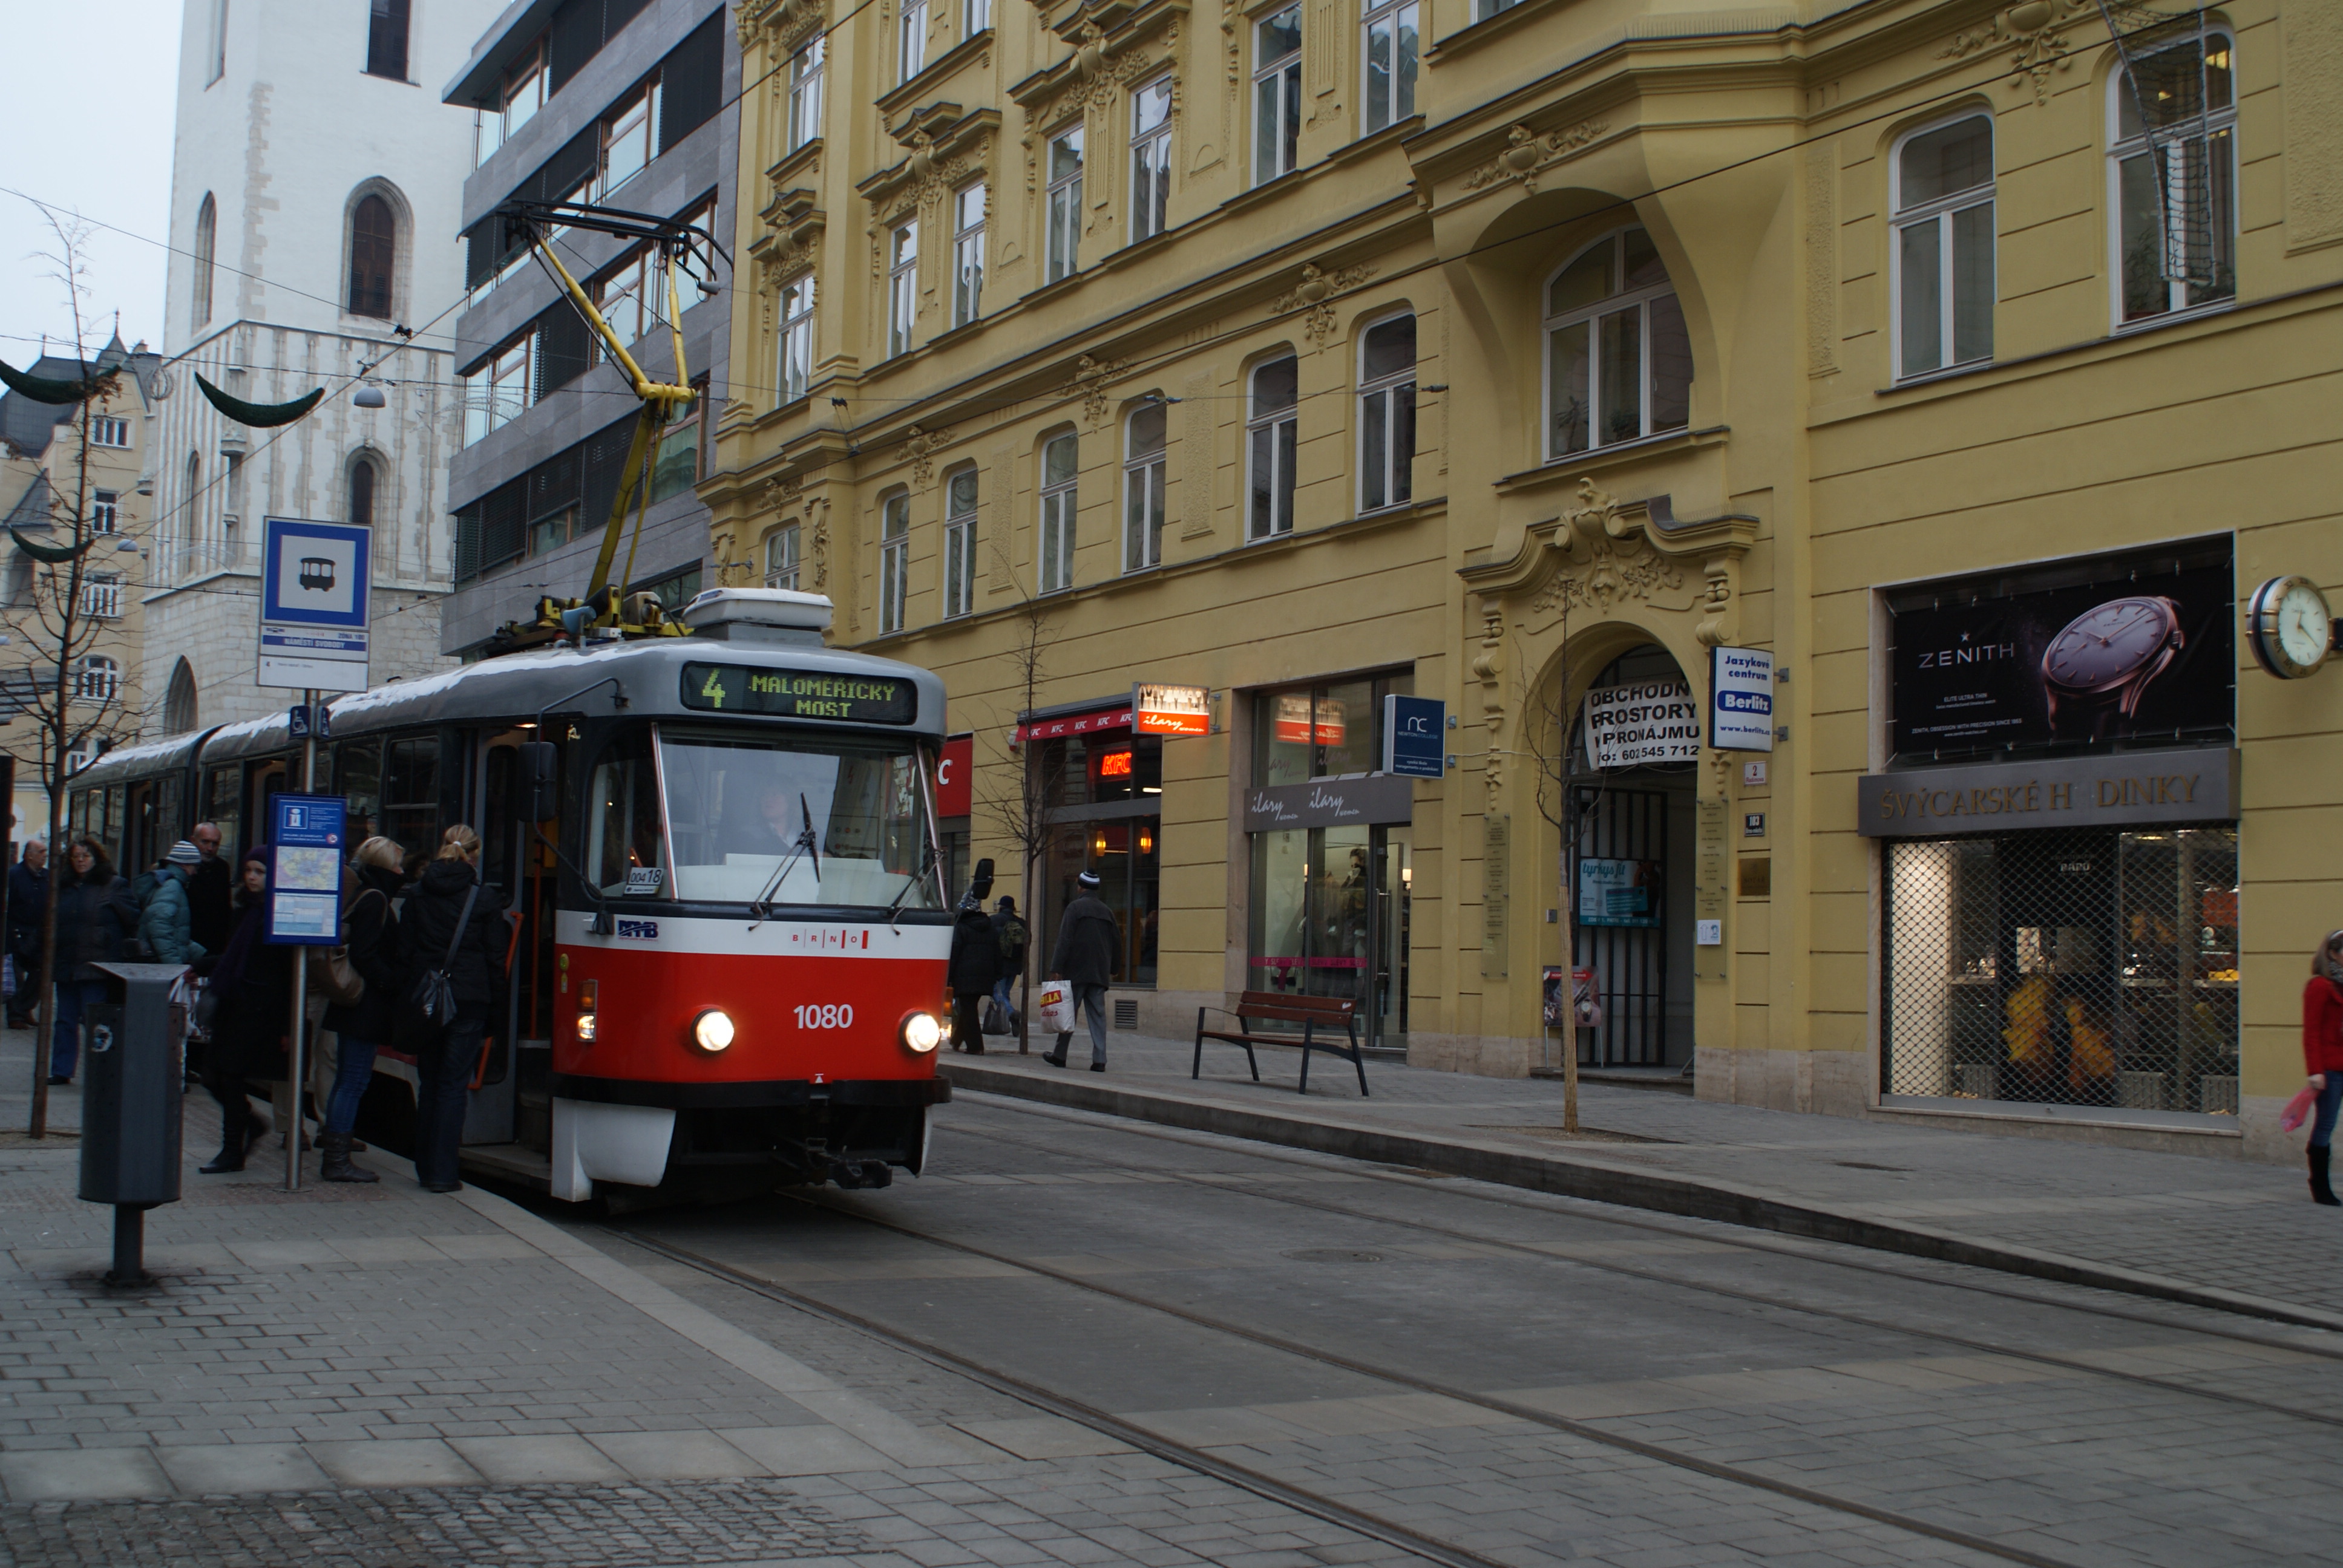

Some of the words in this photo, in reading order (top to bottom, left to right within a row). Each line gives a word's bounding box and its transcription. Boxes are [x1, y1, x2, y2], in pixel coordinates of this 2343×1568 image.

[283, 637, 314, 647] NÁMĚSTÍ
[314, 639, 346, 648] SVOBODY
[1725, 655, 1770, 669] Jazykové
[1918, 642, 2015, 670] ZENITH
[1728, 670, 1768, 681] centrum
[701, 667, 726, 709] 4
[752, 674, 896, 702] MALOMĚŘICKÝ
[796, 699, 853, 717] MOST
[1725, 693, 1769, 711] Berlitz
[1097, 716, 1110, 727] KFC
[1119, 712, 1133, 723] KFC
[1142, 714, 1183, 731] ilary
[1591, 702, 1696, 730] PROSTORY
[1051, 724, 1065, 734] KFC
[1075, 720, 1087, 730] KFC
[1929, 725, 1956, 733] OBSESSION
[1970, 720, 1996, 728] PRECISION
[1602, 724, 1700, 745] PRONÁJMU
[1670, 745, 1700, 756] 712
[1102, 752, 1132, 776] KFC
[1752, 765, 1758, 776] 2
[1251, 791, 1284, 822] ilary
[1279, 812, 1299, 821] women
[1308, 786, 1345, 817] ilary
[1339, 808, 1360, 817] women
[1880, 779, 2040, 820] ŠVÝCARSKÉ
[1749, 815, 1760, 826] 103
[1582, 863, 1614, 879] tyrkys
[1614, 862, 1626, 879] fit
[793, 1004, 854, 1030] 1080
